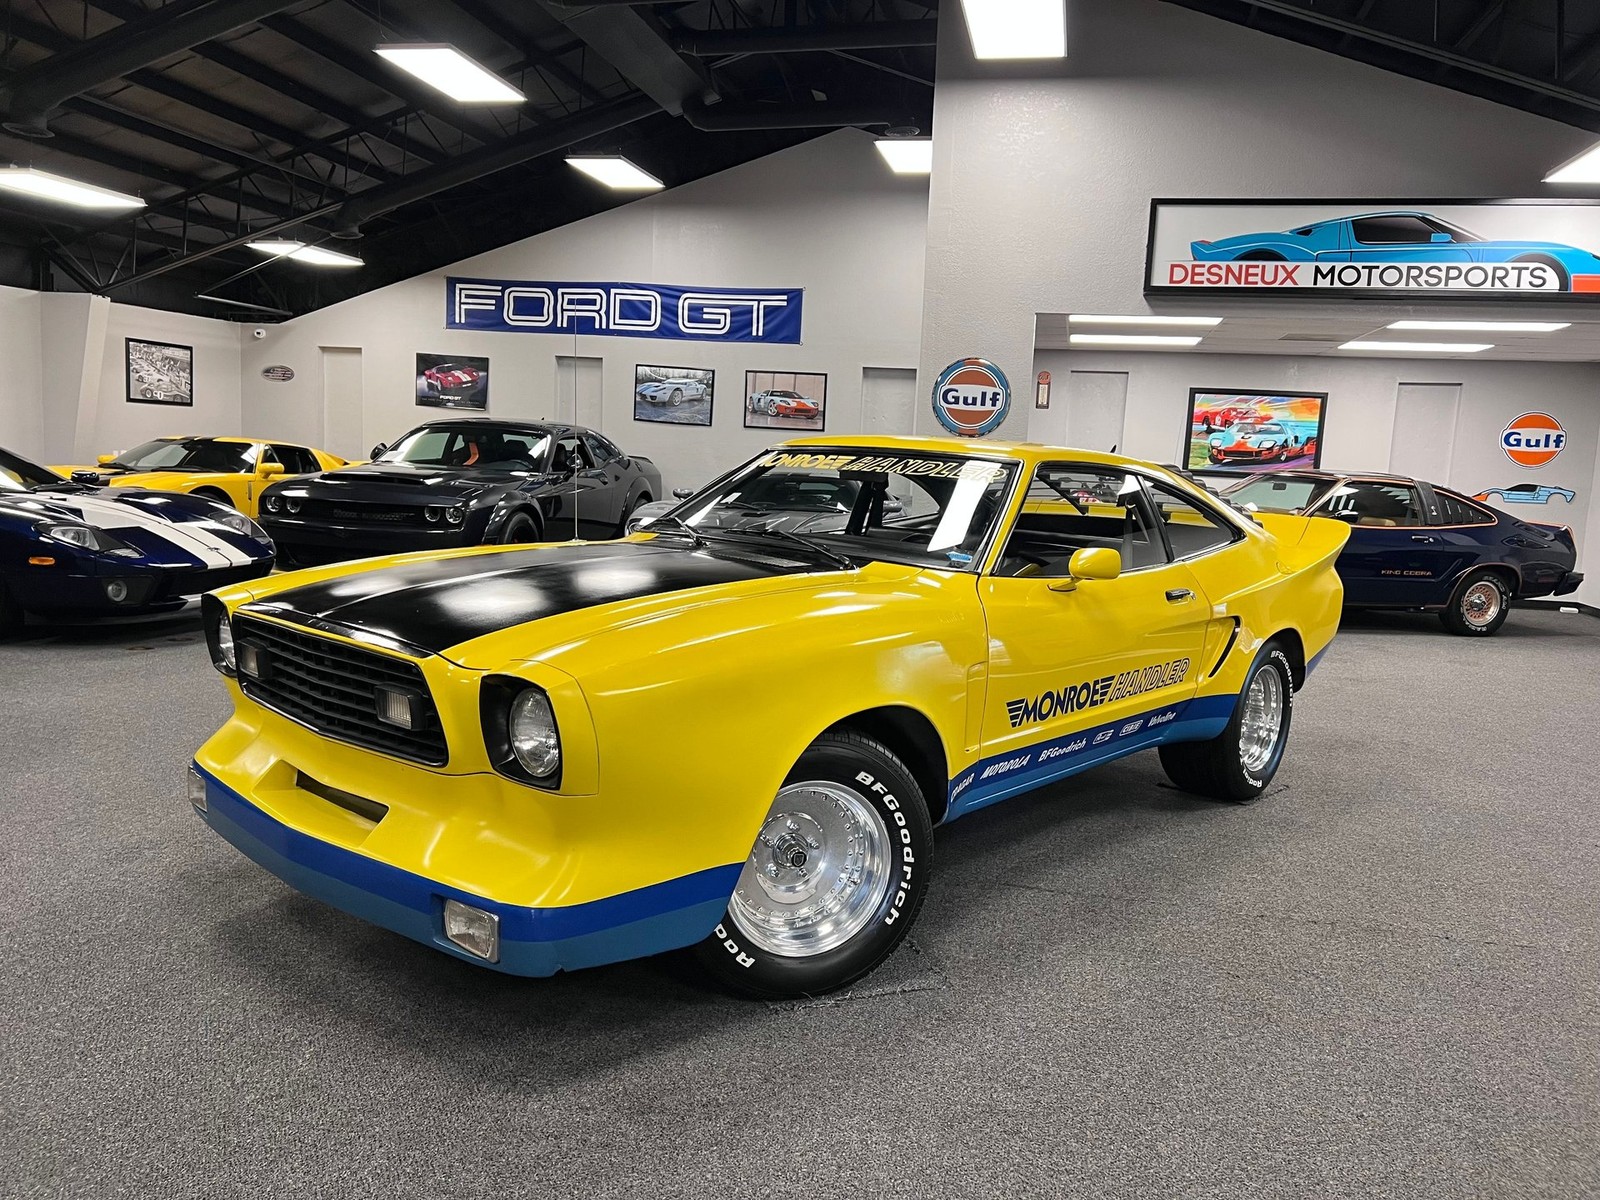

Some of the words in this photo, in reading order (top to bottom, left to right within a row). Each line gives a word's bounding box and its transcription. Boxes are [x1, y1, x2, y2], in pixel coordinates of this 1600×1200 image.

[1168, 263, 1300, 286] DESNEUX
[1313, 264, 1548, 288] MOTORSPORTS
[455, 283, 662, 332] FORD
[678, 292, 788, 337] GT
[941, 387, 1001, 408] Gulf
[1503, 431, 1565, 449] Gulf
[761, 453, 844, 470] ONROE
[842, 456, 1008, 483] HANDLER
[1012, 677, 1108, 727] MONROE
[1108, 657, 1190, 702] HANDLER
[980, 753, 1032, 780] MOTOROLA
[1038, 737, 1087, 762] BFGoodrich
[855, 771, 915, 925] BFGoodrich
[713, 923, 756, 969] Rad
